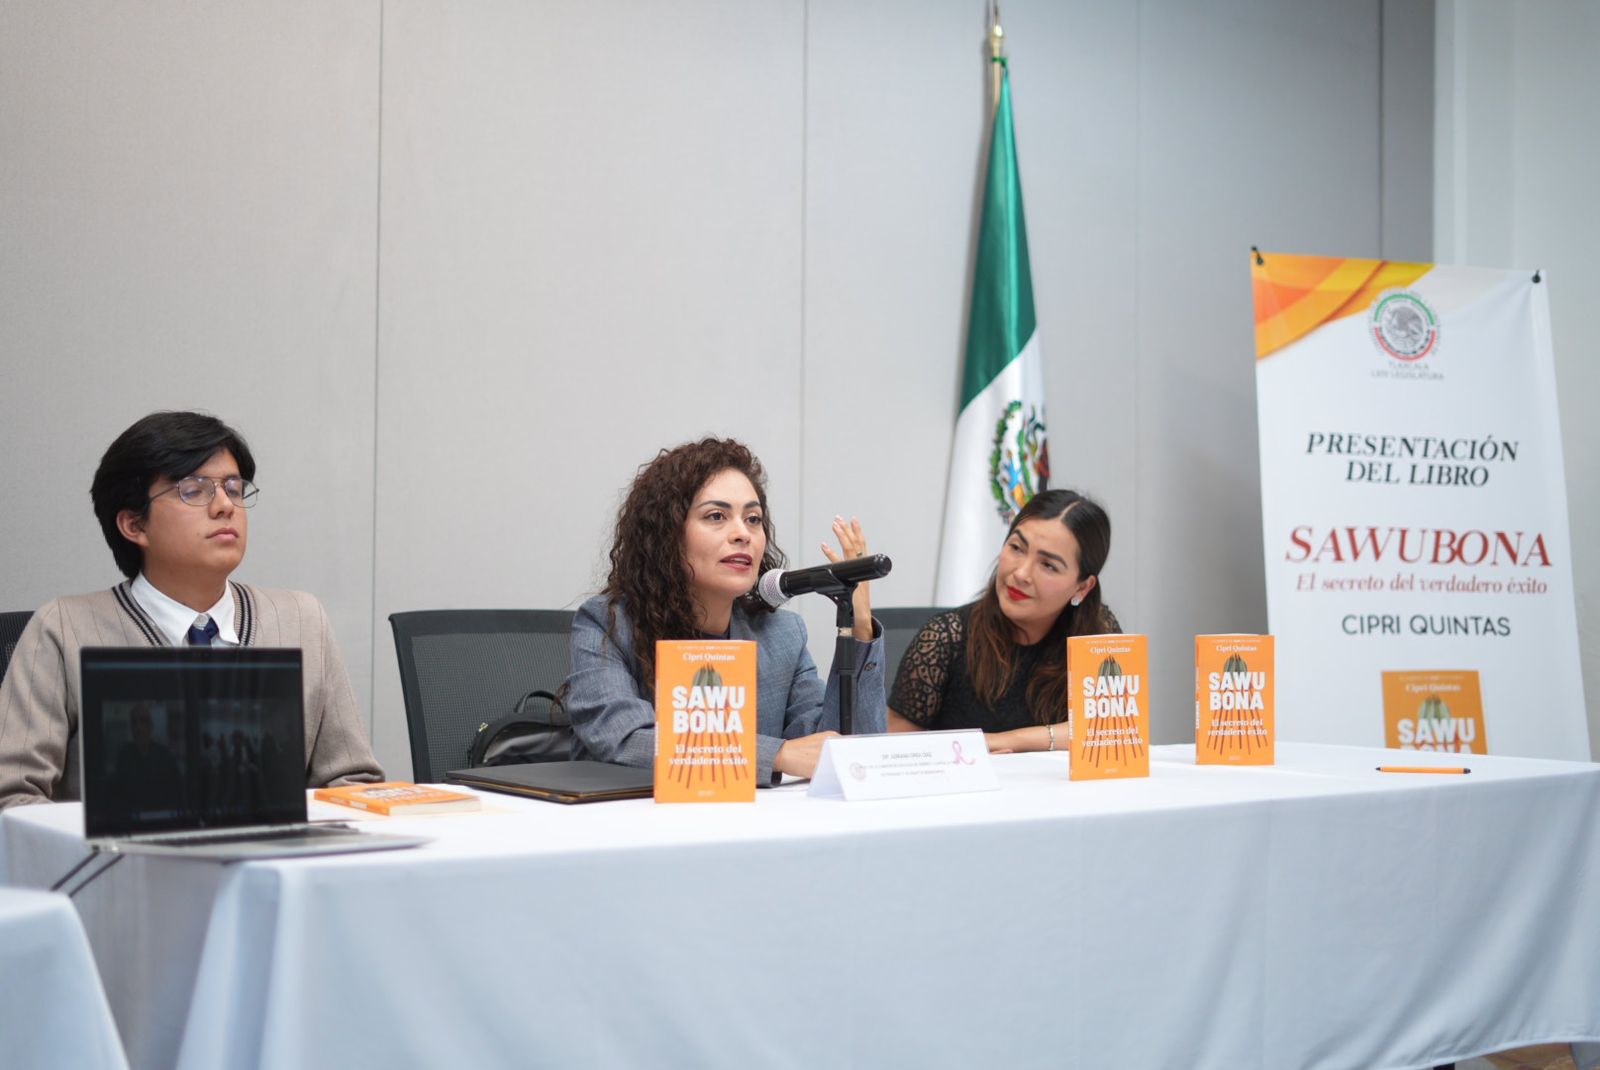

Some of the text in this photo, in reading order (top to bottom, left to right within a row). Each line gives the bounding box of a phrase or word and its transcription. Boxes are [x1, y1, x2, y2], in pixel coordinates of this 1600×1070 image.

[1306, 432, 1519, 463] PRESENTACIÓN
[1345, 460, 1490, 488] DEL LIBRO
[1284, 525, 1553, 568] SAWUBONA
[1296, 573, 1548, 595] El secreto del verdadero éxito
[1341, 614, 1512, 637] CIPRI QUINTAS
[1082, 675, 1140, 698] SAWU
[1208, 672, 1266, 690] SAWU
[671, 686, 746, 710] SAWU
[1084, 697, 1139, 720] BONA
[1210, 692, 1264, 710] BONA
[672, 710, 744, 734] BONA
[1397, 717, 1476, 744] SAWU
